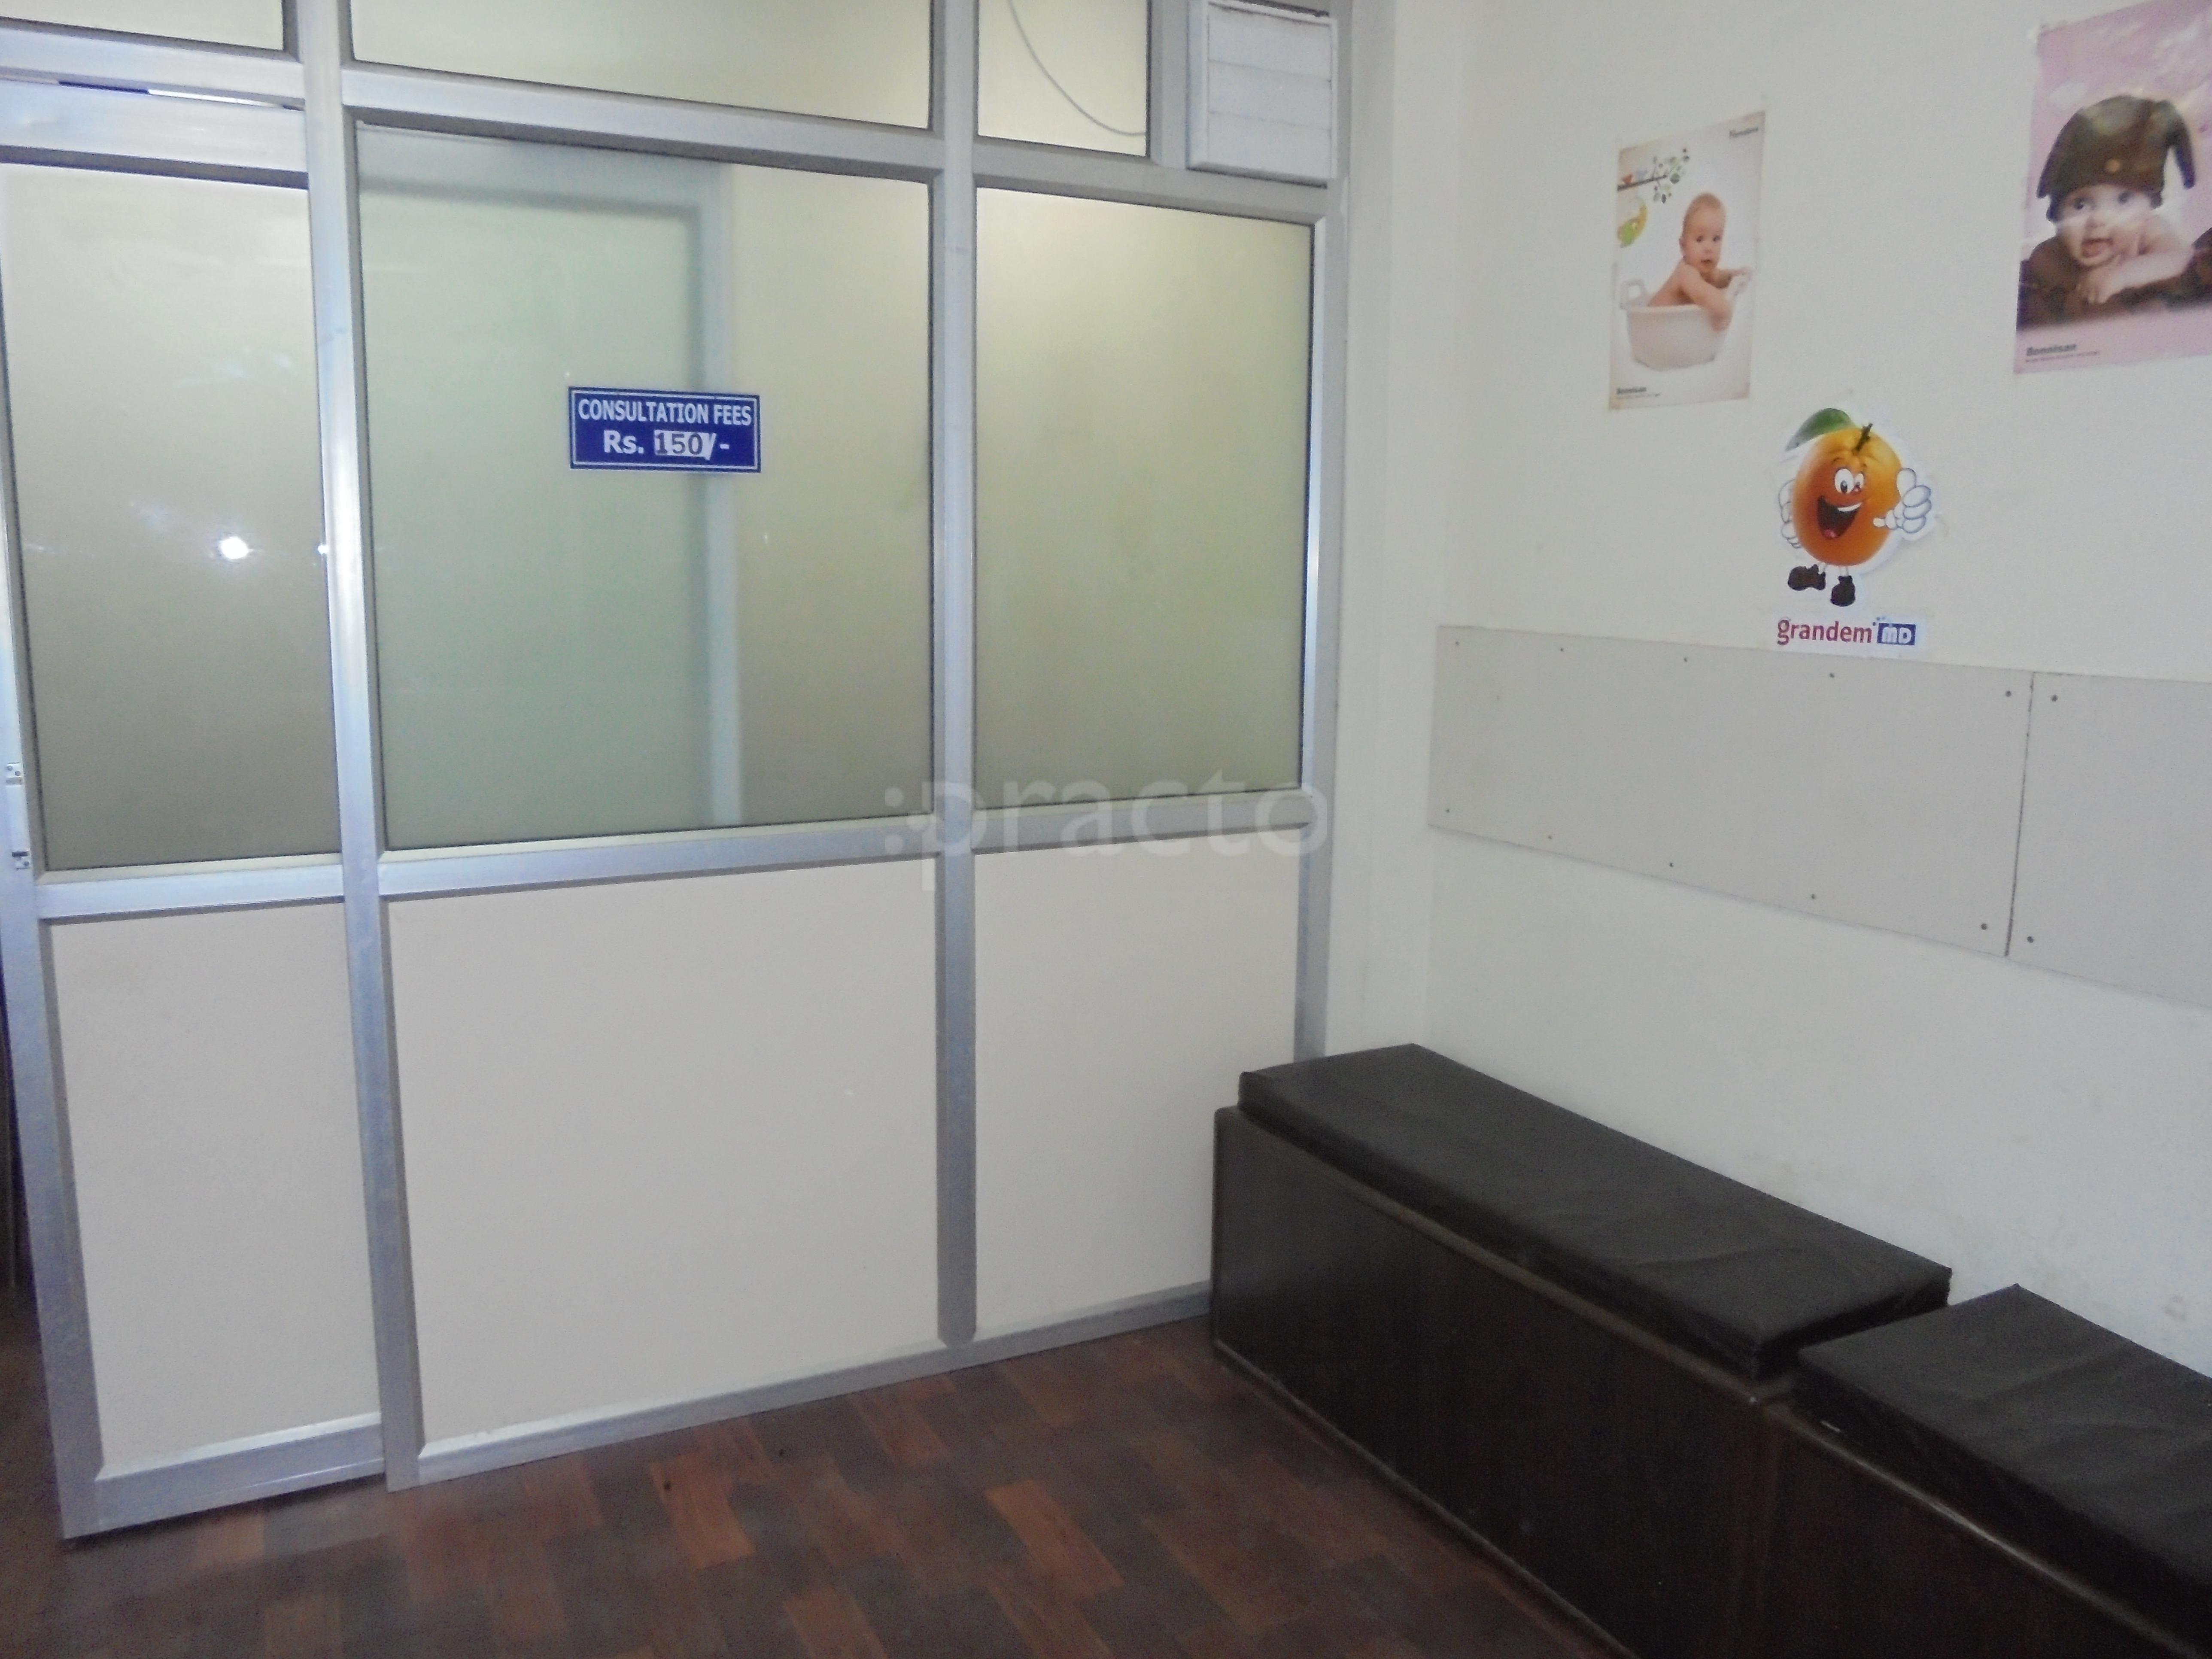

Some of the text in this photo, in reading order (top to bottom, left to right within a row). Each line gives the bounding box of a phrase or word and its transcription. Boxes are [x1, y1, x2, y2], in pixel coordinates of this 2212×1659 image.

[578, 398, 752, 425] CONSULTATION FEES
[603, 430, 644, 454] Rs.
[1777, 618, 1872, 645] grandem
